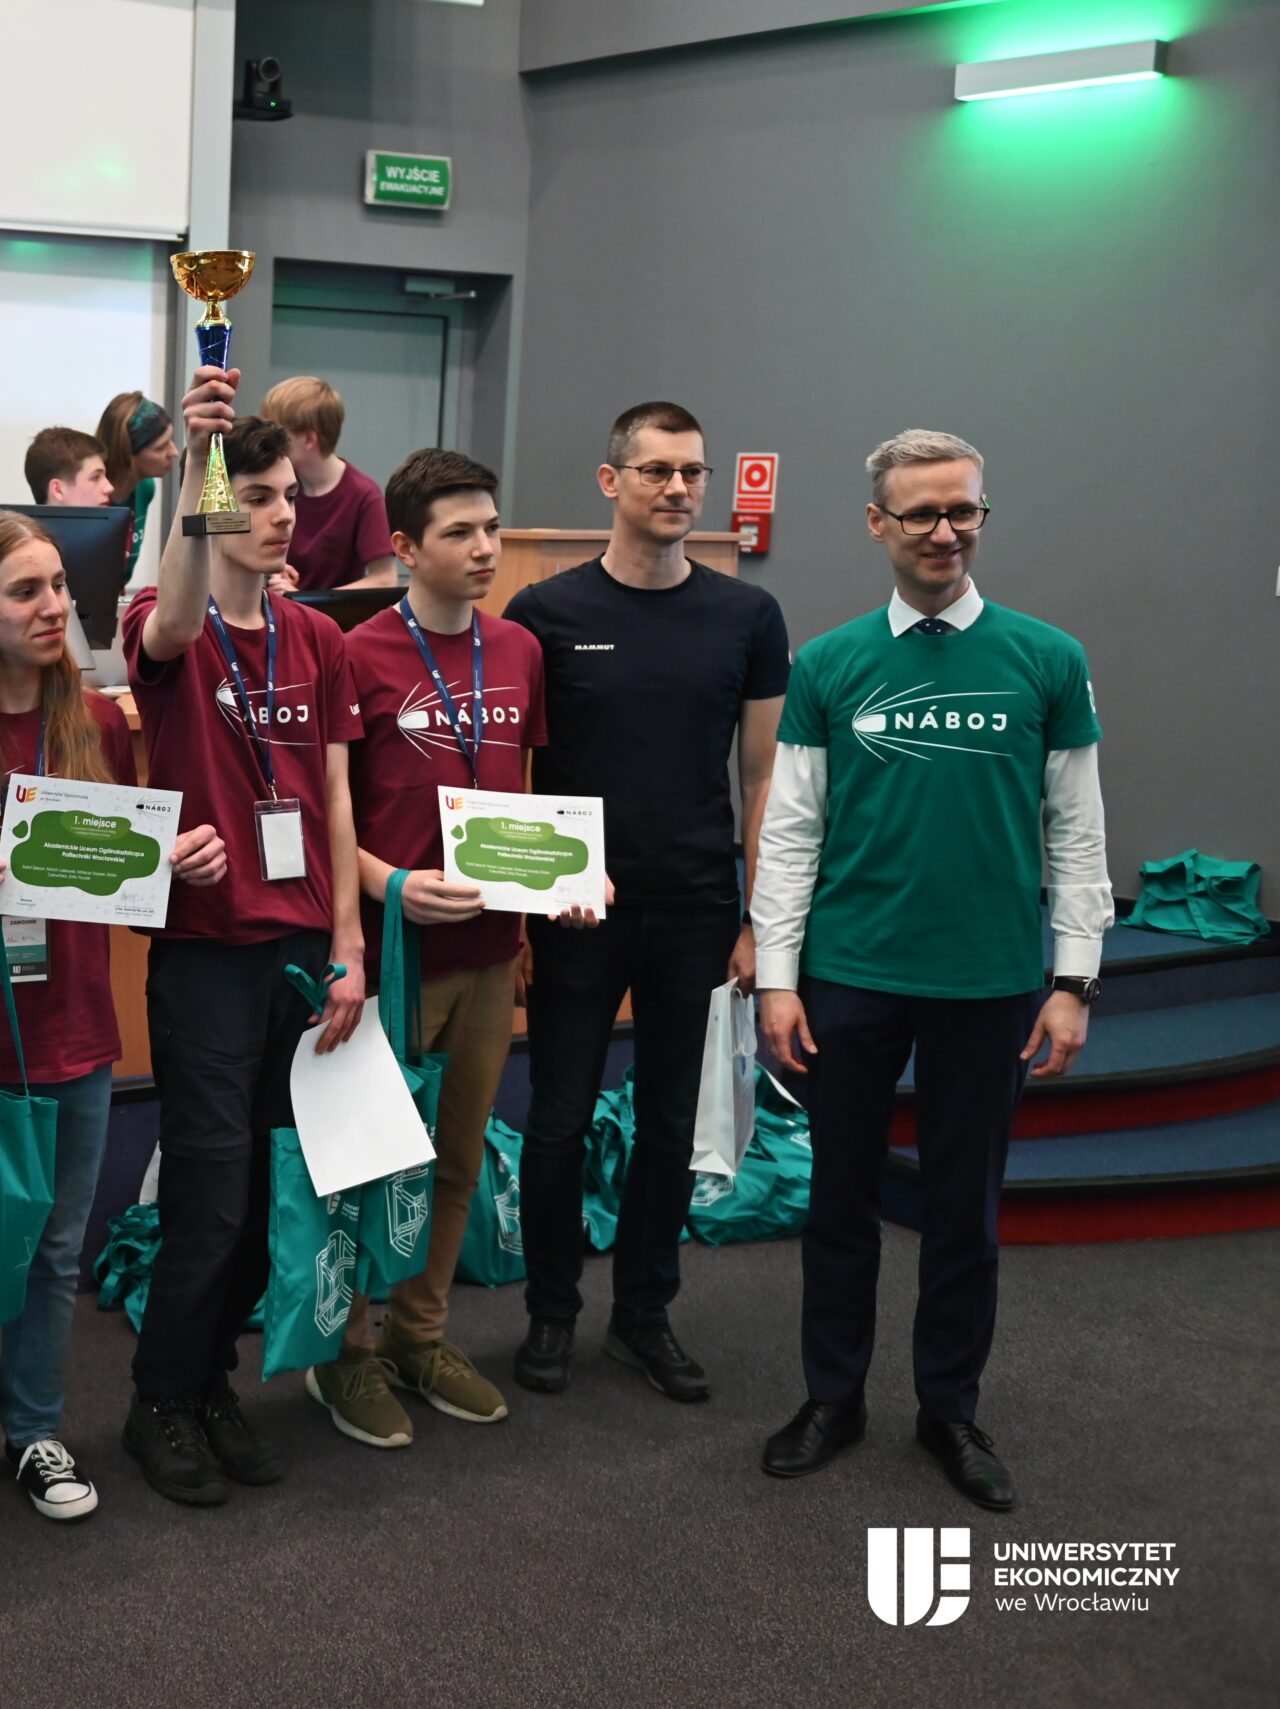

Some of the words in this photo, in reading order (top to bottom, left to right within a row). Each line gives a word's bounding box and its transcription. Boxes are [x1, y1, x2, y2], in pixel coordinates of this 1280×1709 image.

[385, 165, 440, 183] WYJŚCIE
[243, 701, 309, 724] ÁBOJ
[894, 705, 1008, 731] NÁBOJ
[15, 784, 38, 803] UE
[445, 795, 464, 811] UE
[73, 815, 80, 825] 1.
[82, 817, 117, 829] miejsce
[500, 821, 508, 830] 1.
[508, 822, 541, 833] miejsce
[43, 841, 78, 852] Akademickie
[79, 844, 98, 853] Liceum
[61, 851, 91, 861] Politechniki
